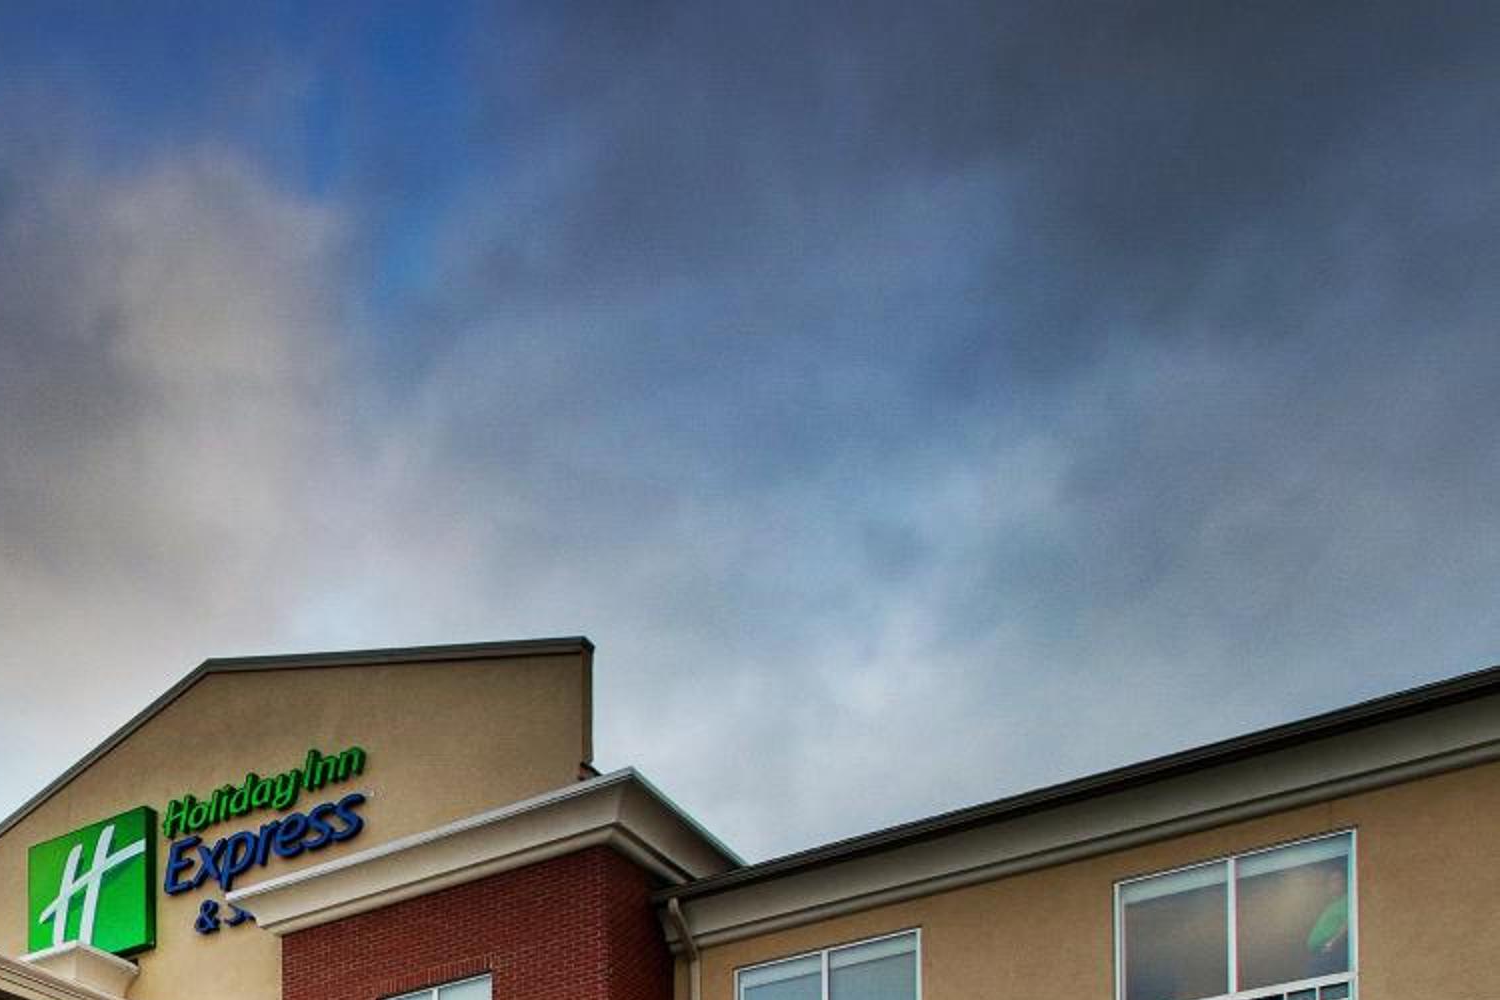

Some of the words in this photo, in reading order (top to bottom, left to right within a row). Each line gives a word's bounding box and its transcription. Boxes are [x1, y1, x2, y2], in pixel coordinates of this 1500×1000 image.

[163, 768, 302, 839] Holiday
[302, 747, 366, 792] Inn
[164, 793, 366, 895] Express
[194, 899, 221, 935] &
